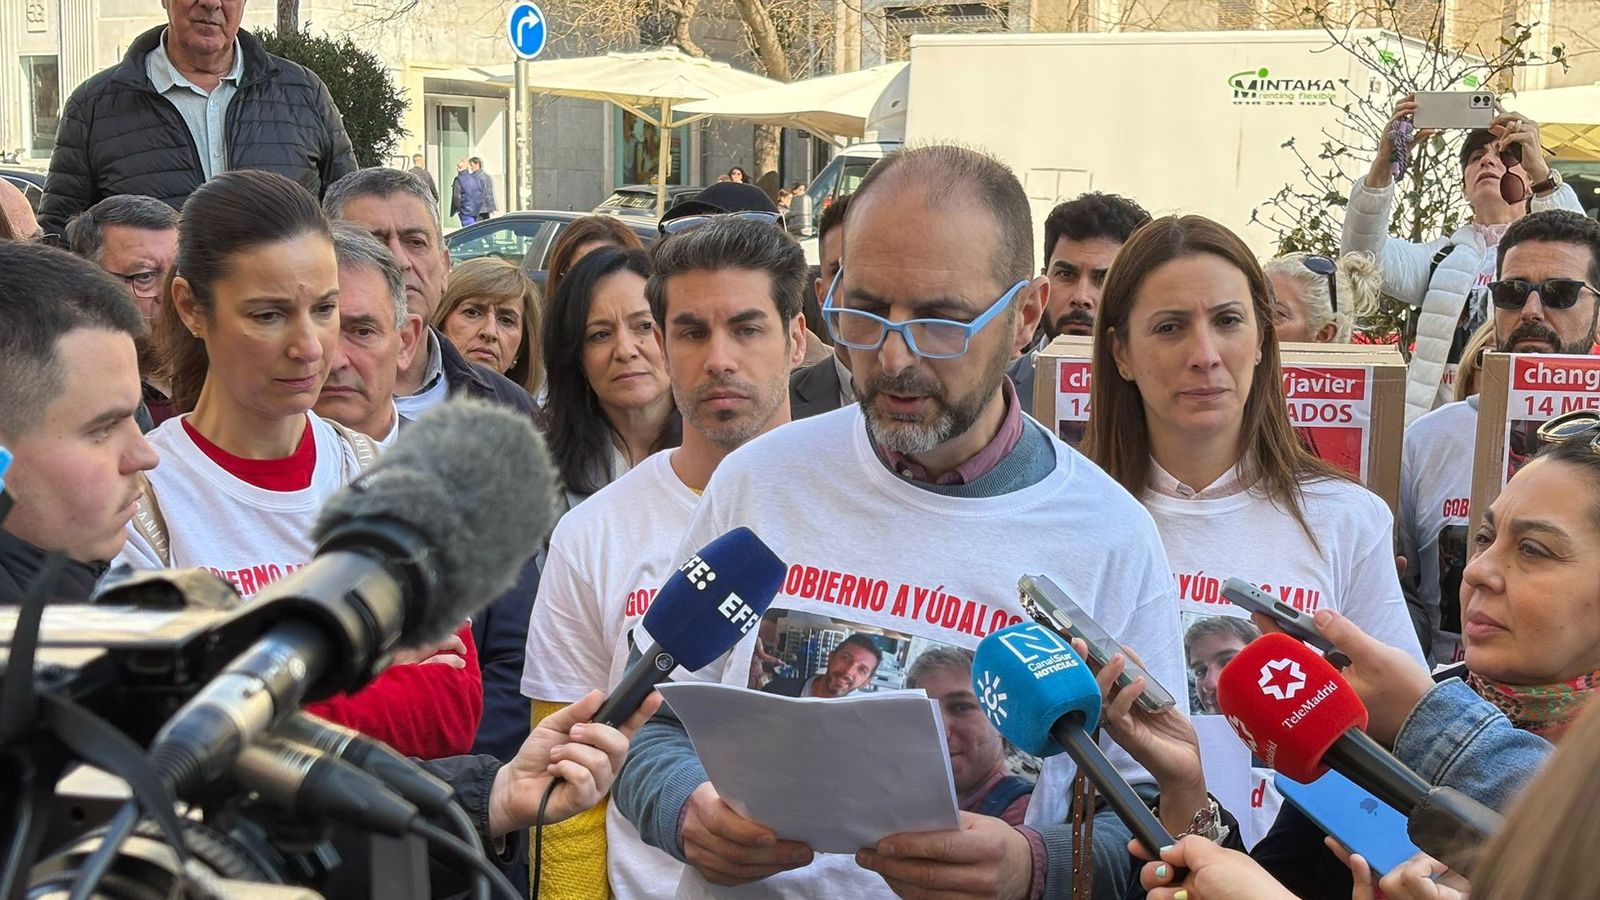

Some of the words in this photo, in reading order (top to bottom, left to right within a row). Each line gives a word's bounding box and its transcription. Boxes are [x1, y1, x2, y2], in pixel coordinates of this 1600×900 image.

[1234, 79, 1337, 99] MINTAKA
[1258, 92, 1295, 101] renting
[1298, 92, 1337, 101] flexible
[1524, 362, 1600, 392] chang
[1525, 395, 1554, 417] 14
[679, 554, 717, 590] FE:
[780, 563, 889, 613] OBIERNO
[625, 588, 658, 617] GO
[1027, 652, 1073, 672] CanalSur
[1033, 659, 1080, 679] NOTICIAS
[1281, 680, 1339, 729] TeleMadrid
